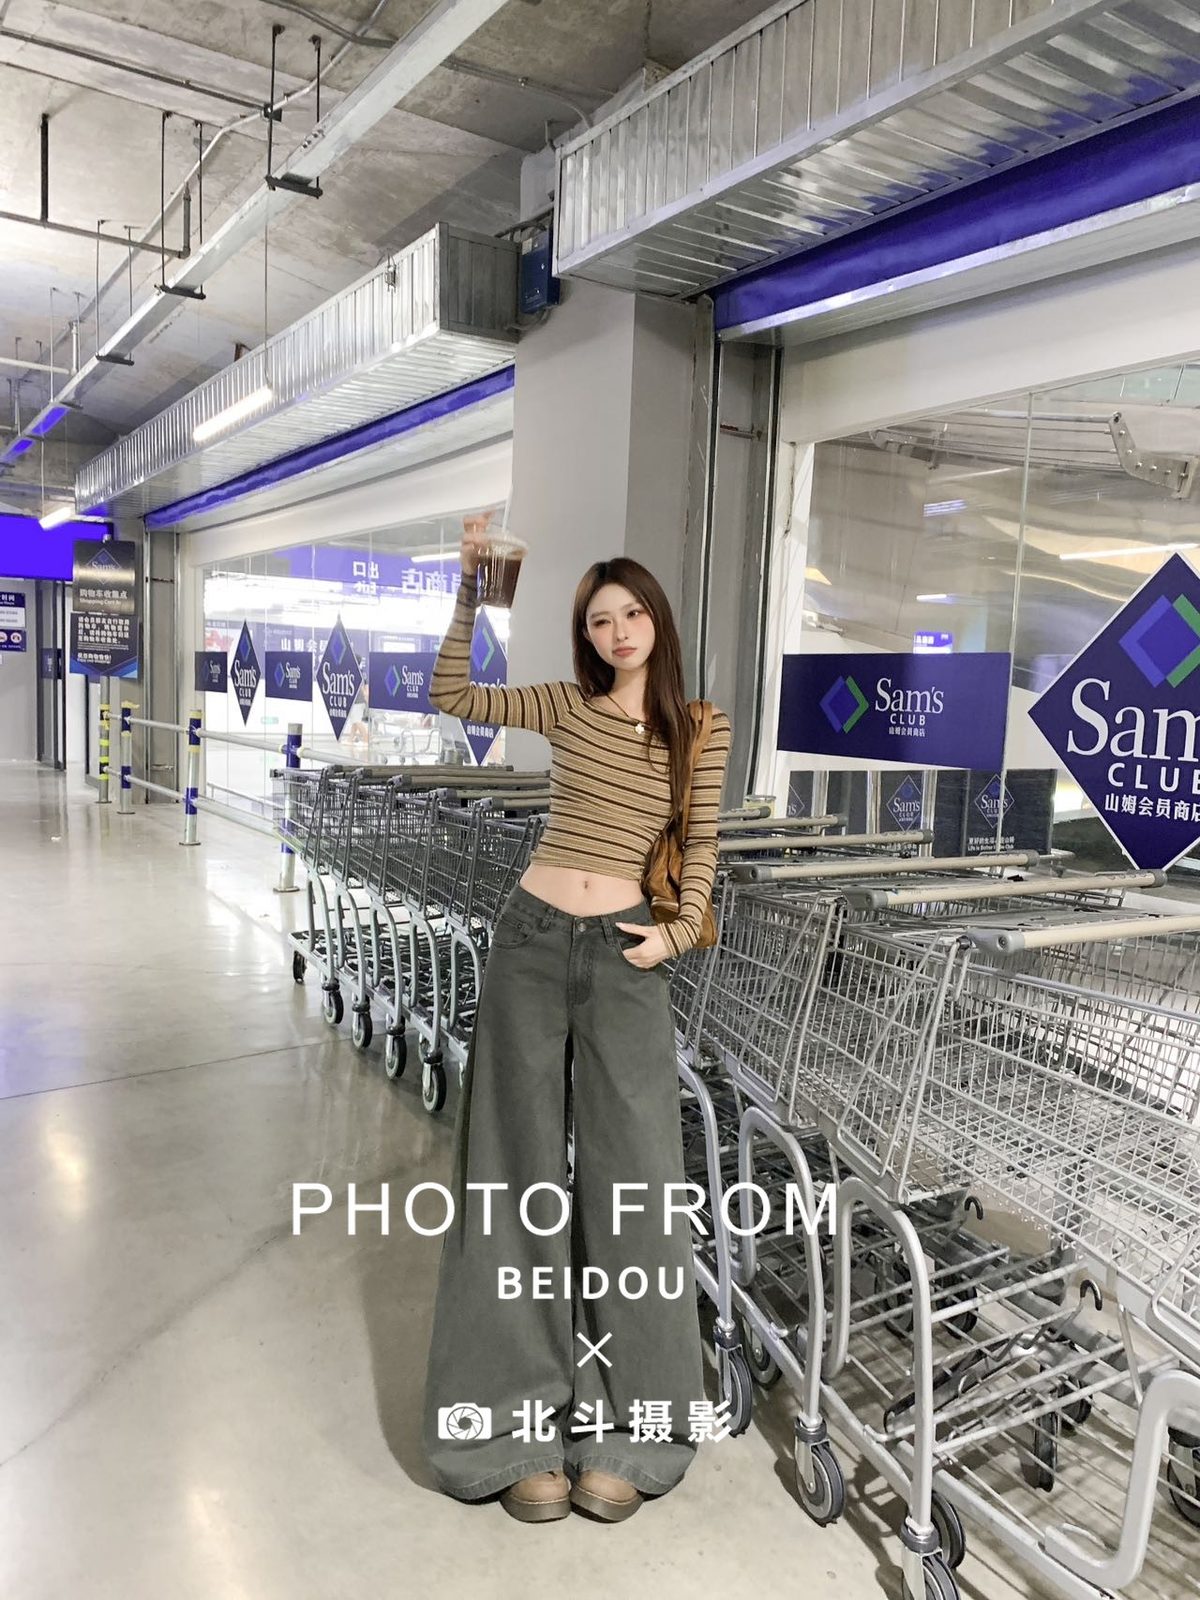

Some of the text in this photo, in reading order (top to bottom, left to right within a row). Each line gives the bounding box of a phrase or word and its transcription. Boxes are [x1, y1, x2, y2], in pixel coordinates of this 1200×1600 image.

[234, 659, 257, 688] Sam's
[285, 661, 301, 679] Sam's
[322, 661, 355, 696] Sam's
[401, 665, 424, 686] Sam's
[329, 695, 347, 708] CLUB
[875, 677, 945, 714] Sam's
[890, 713, 926, 726] CLUB
[892, 797, 921, 814] Sam's
[980, 794, 1009, 810] Sams
